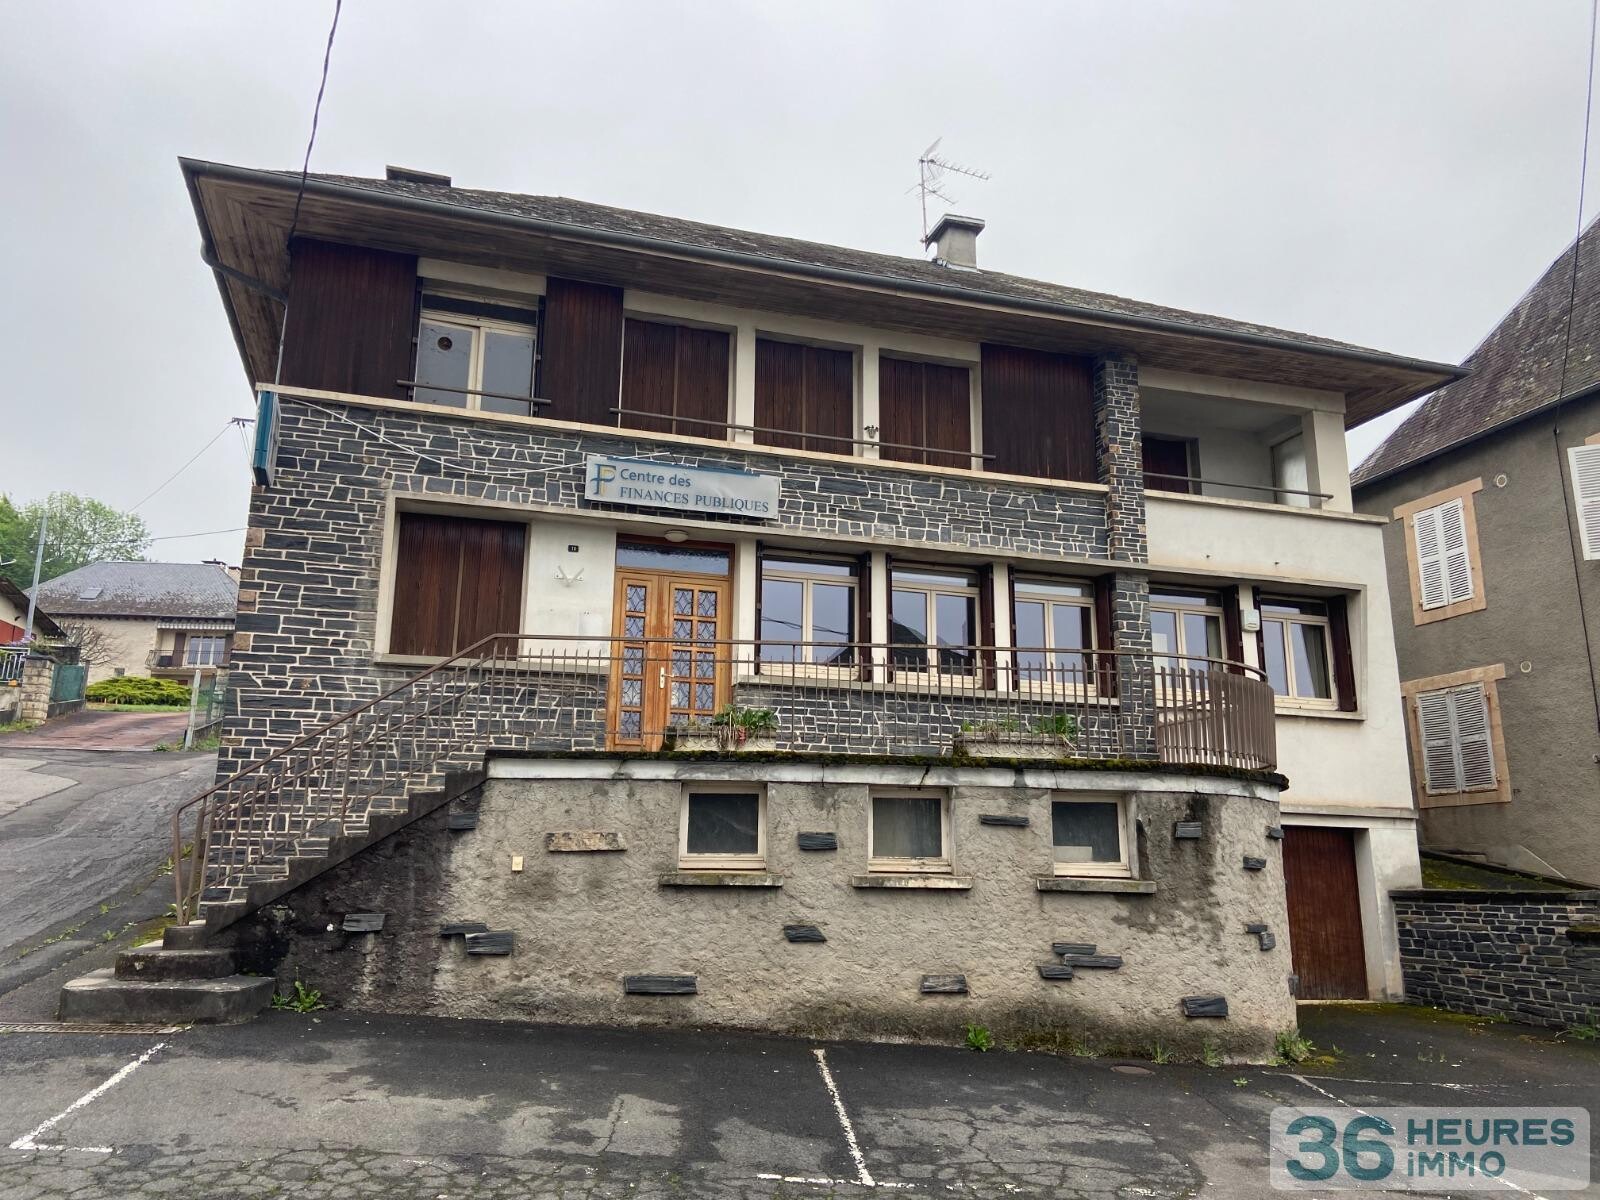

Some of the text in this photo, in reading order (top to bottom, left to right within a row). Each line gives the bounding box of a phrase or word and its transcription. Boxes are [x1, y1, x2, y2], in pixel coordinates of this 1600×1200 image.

[620, 468, 691, 488] Centre des
[620, 486, 769, 513] FINANCES PUBLIQUES
